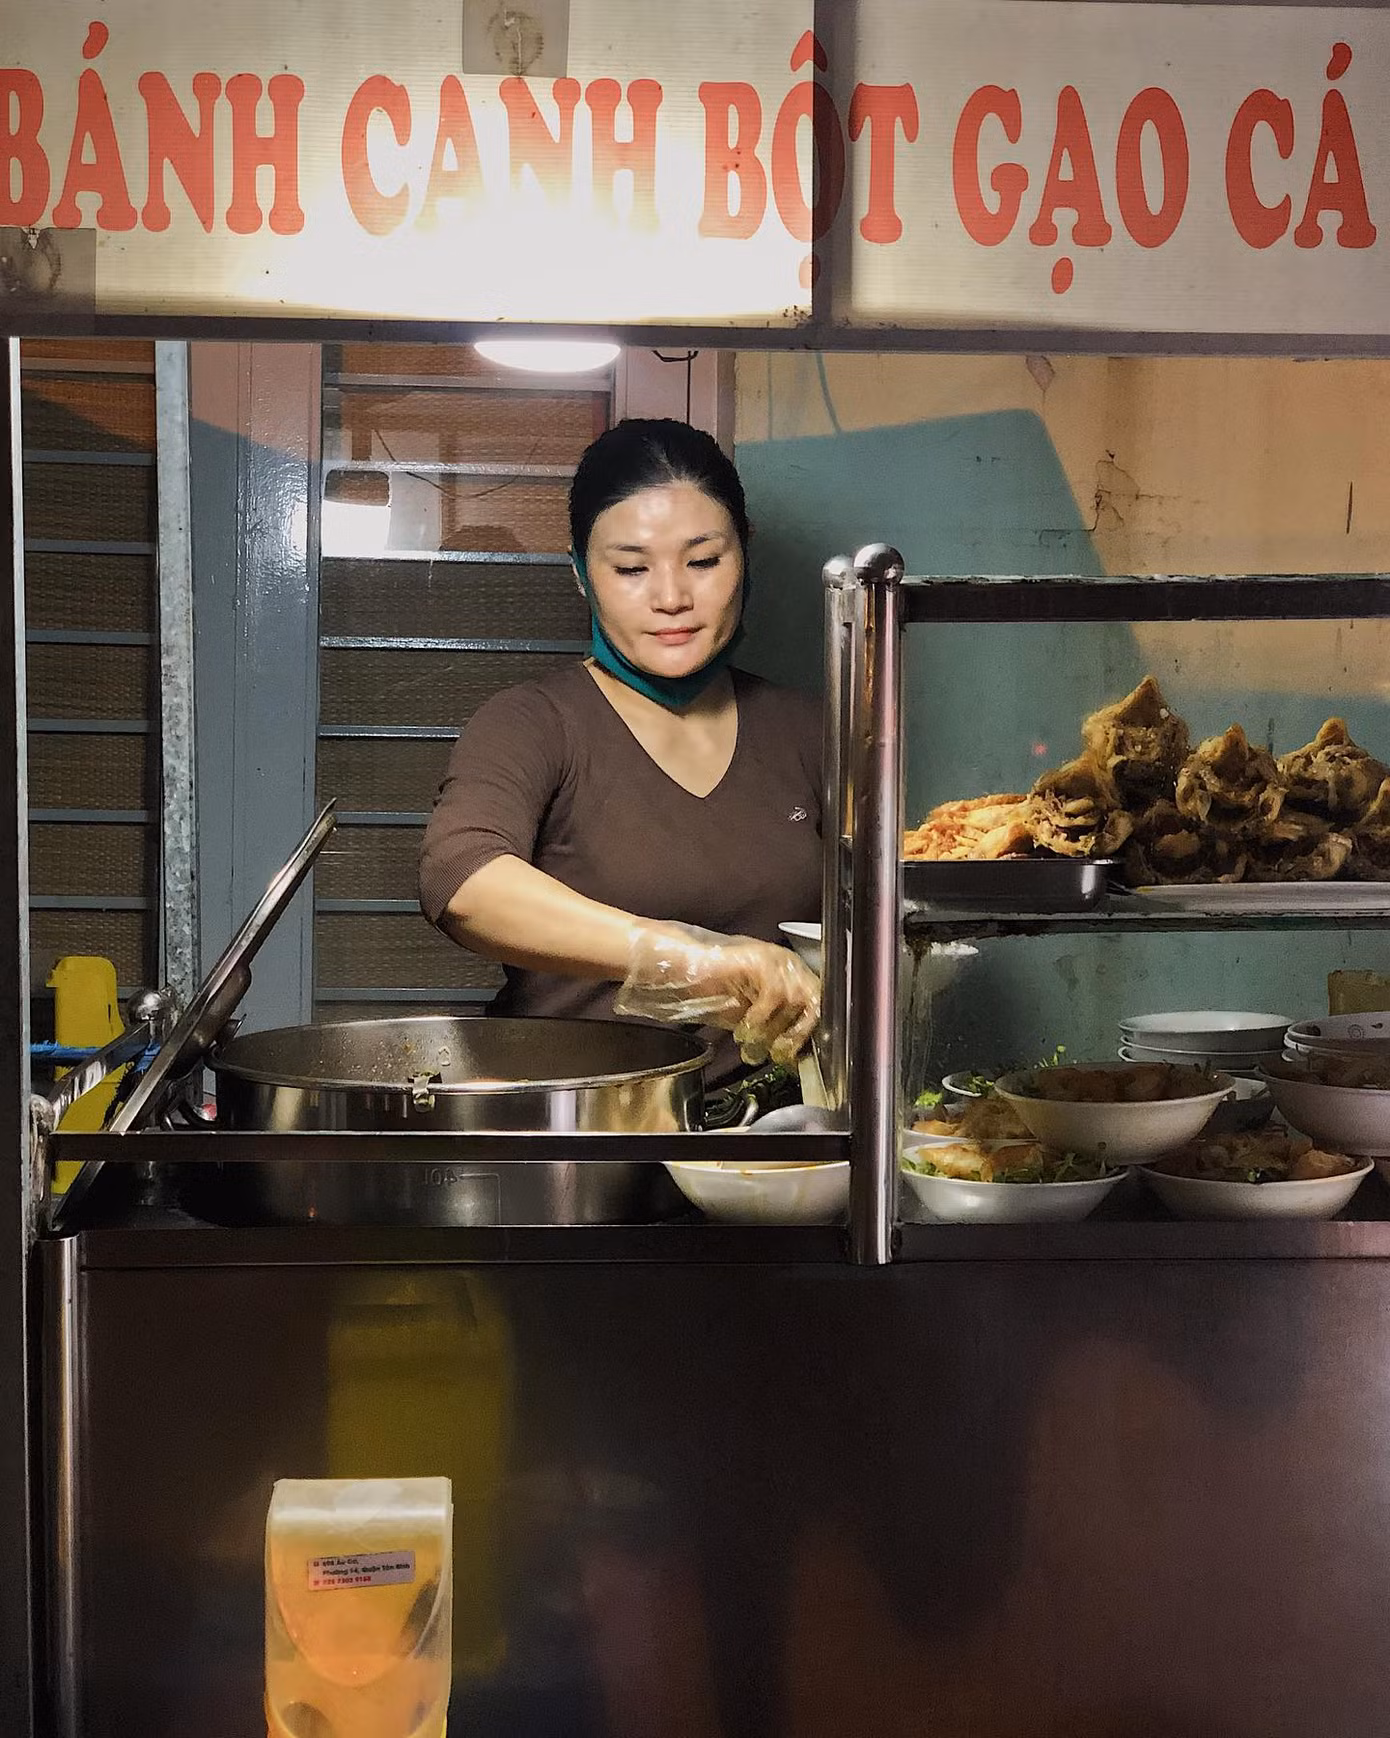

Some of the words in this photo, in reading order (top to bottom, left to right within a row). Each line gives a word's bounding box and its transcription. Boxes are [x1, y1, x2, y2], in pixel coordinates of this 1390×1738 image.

[0, 21, 304, 235] BÁNH
[341, 74, 664, 236] CANH
[698, 30, 919, 289] BỘT
[952, 85, 1190, 294] GẠO
[1225, 42, 1377, 249] CÁ
